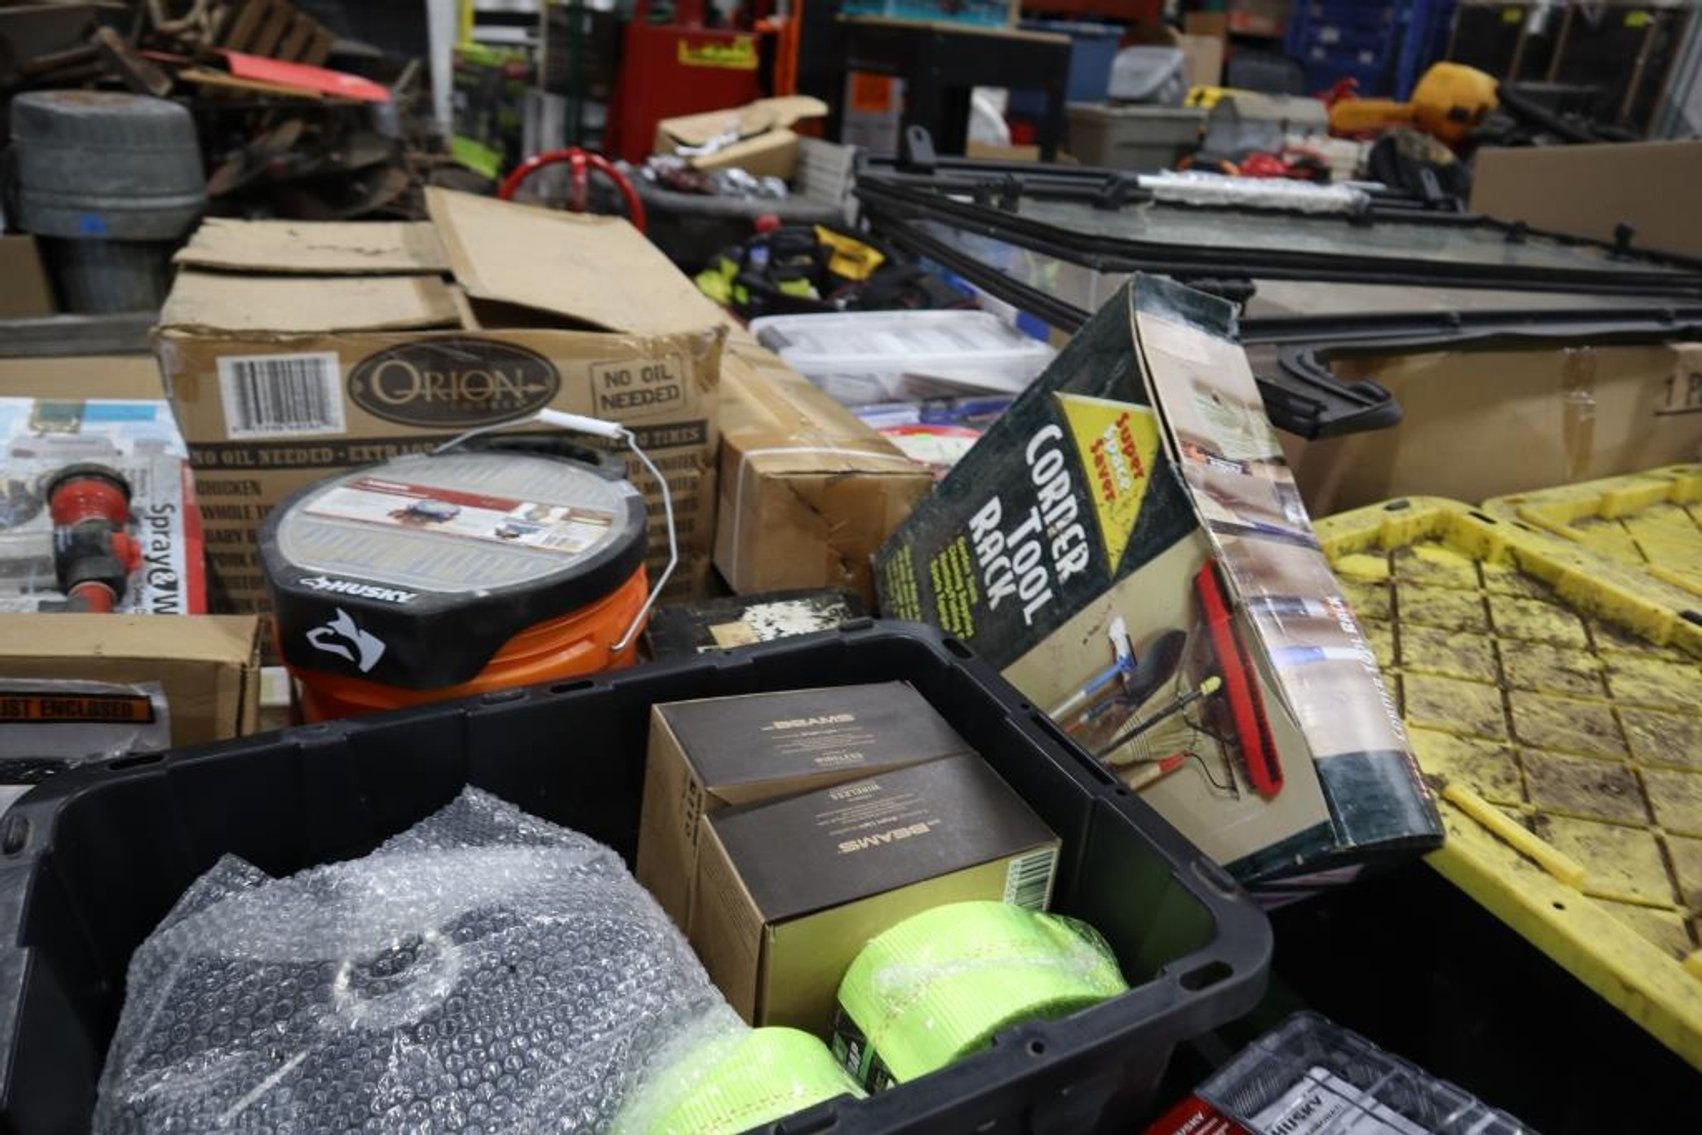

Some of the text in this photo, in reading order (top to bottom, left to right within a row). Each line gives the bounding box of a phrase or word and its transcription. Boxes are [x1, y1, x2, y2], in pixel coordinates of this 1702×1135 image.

[601, 384, 679, 411] NEEDED
[604, 363, 674, 388] NO OIL
[222, 450, 254, 466] OIL
[261, 448, 334, 464] NEEDED
[1090, 437, 1117, 501] Saver
[1104, 423, 1132, 492] Space
[1115, 412, 1145, 480] Super
[1026, 424, 1090, 585] CORNER
[968, 495, 1017, 611] RACK
[1006, 506, 1053, 626] TOOL
[328, 580, 416, 603] HUSKY
[773, 713, 855, 729] BEAMS
[838, 822, 931, 853] BEAMS
